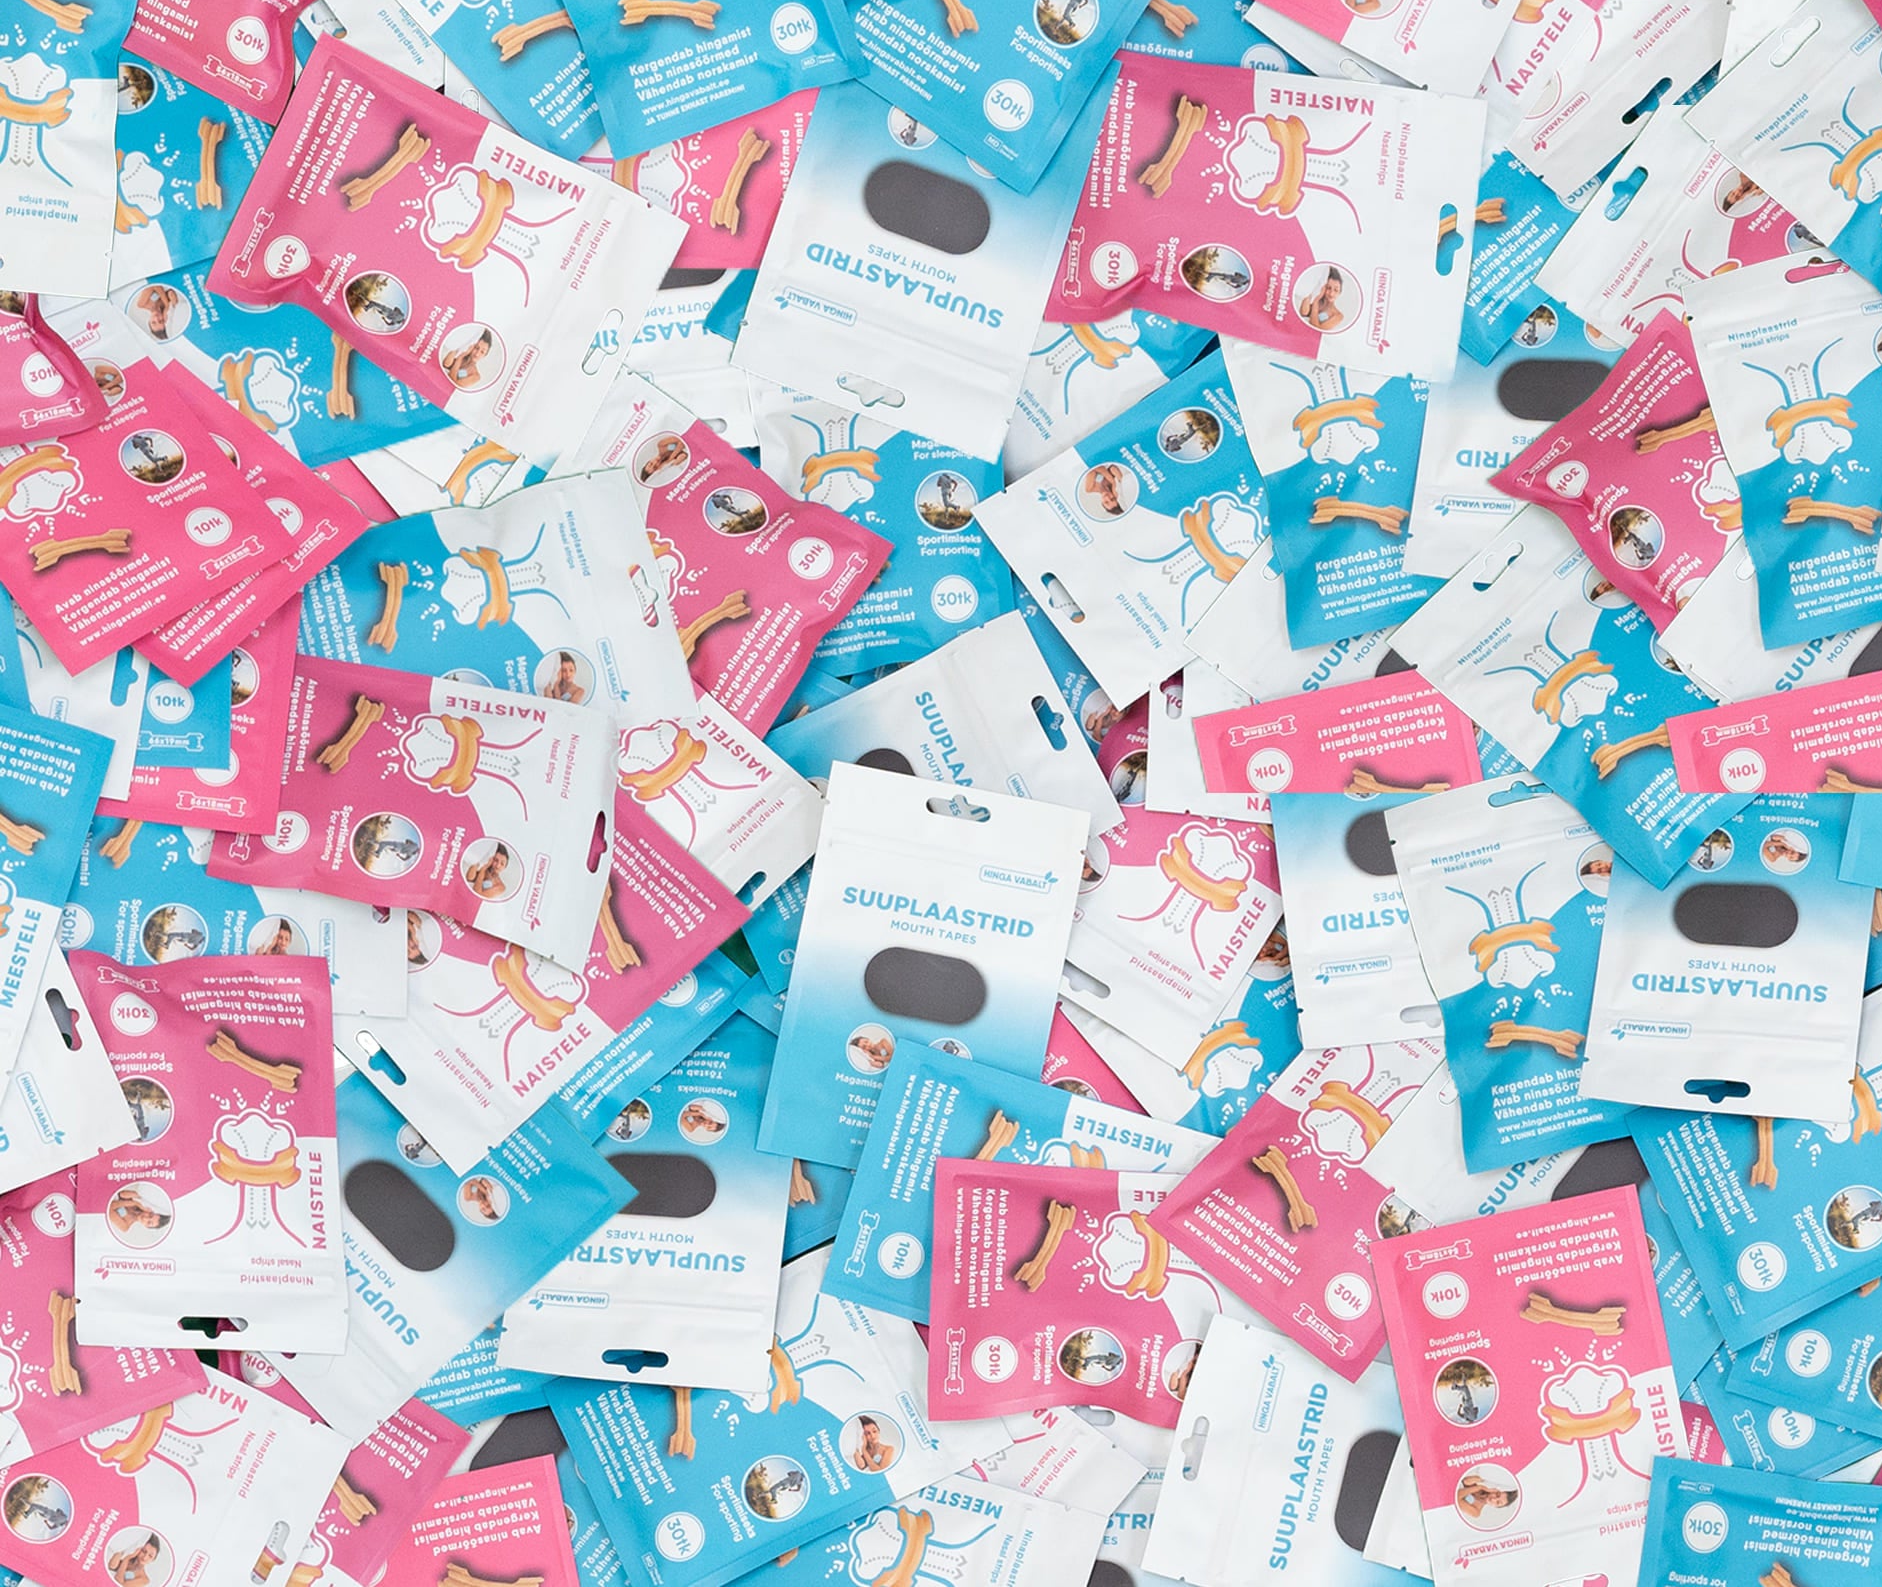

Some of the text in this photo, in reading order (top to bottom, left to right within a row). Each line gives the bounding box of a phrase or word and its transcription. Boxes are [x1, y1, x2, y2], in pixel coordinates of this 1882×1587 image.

[776, 19, 813, 38] 30tk
[629, 26, 752, 77] Kergendab hingamist
[634, 43, 740, 90] Avab ninasõõrmed
[1505, 7, 1573, 97] NAISTELE
[636, 51, 758, 102] Vähendab norskamist
[990, 89, 1030, 125] 30tk
[1270, 88, 1374, 116] NAISTELE
[490, 146, 586, 203] NAISTELE
[193, 517, 224, 535] 10tk
[917, 533, 982, 547] Sportimiseks
[937, 589, 976, 608] 30tk
[155, 695, 186, 708] 10tk
[445, 695, 547, 724] NAISTELE
[1208, 896, 1267, 981] NAISTELE
[512, 1022, 592, 1098] NAISTELE
[308, 1151, 327, 1250] NAISTELE
[605, 1229, 695, 1244] MOUTH TAPES
[1333, 1283, 1362, 1311] 30tk
[1269, 1383, 1328, 1571] SUUPLAASTRID
[1306, 1437, 1335, 1523] MOUTH TAPES
